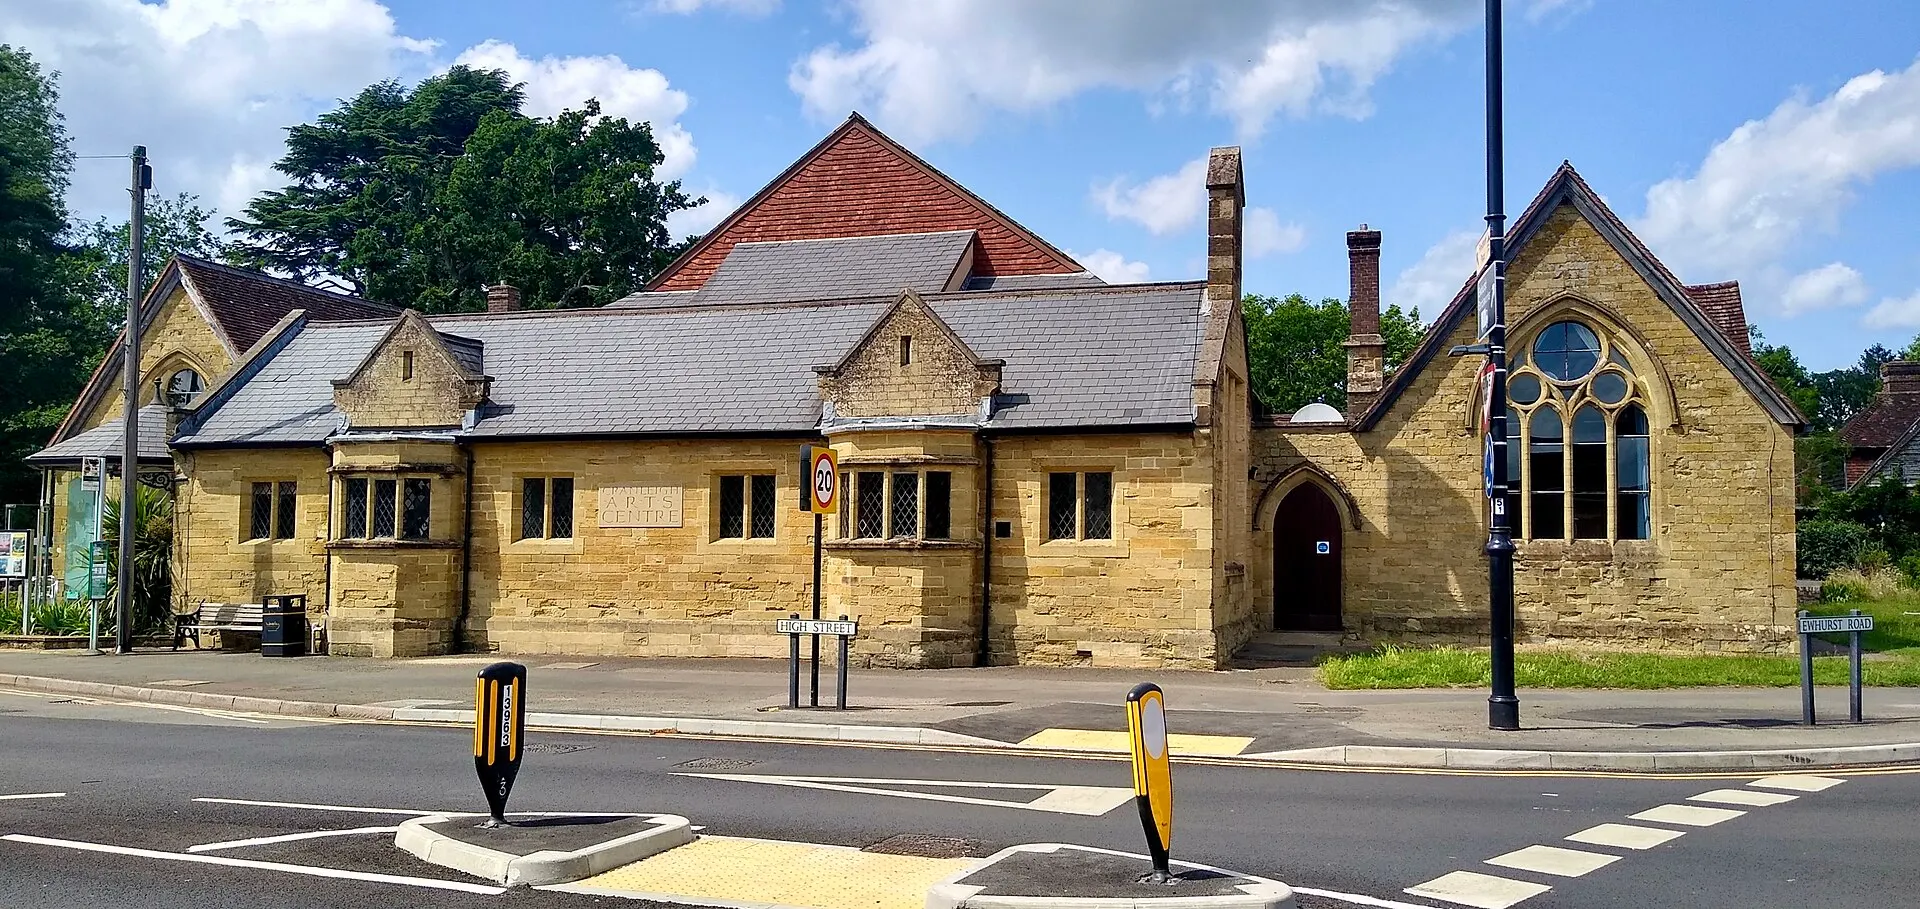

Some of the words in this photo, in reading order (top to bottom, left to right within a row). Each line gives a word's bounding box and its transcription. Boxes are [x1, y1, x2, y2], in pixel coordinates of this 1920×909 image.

[817, 469, 832, 492] 20
[602, 510, 679, 523] CENTRE
[780, 621, 807, 631] HIGH
[813, 622, 852, 633] STREET
[1802, 619, 1843, 631] EWHURST
[1848, 618, 1872, 630] ROAD
[502, 685, 511, 746] 13963
